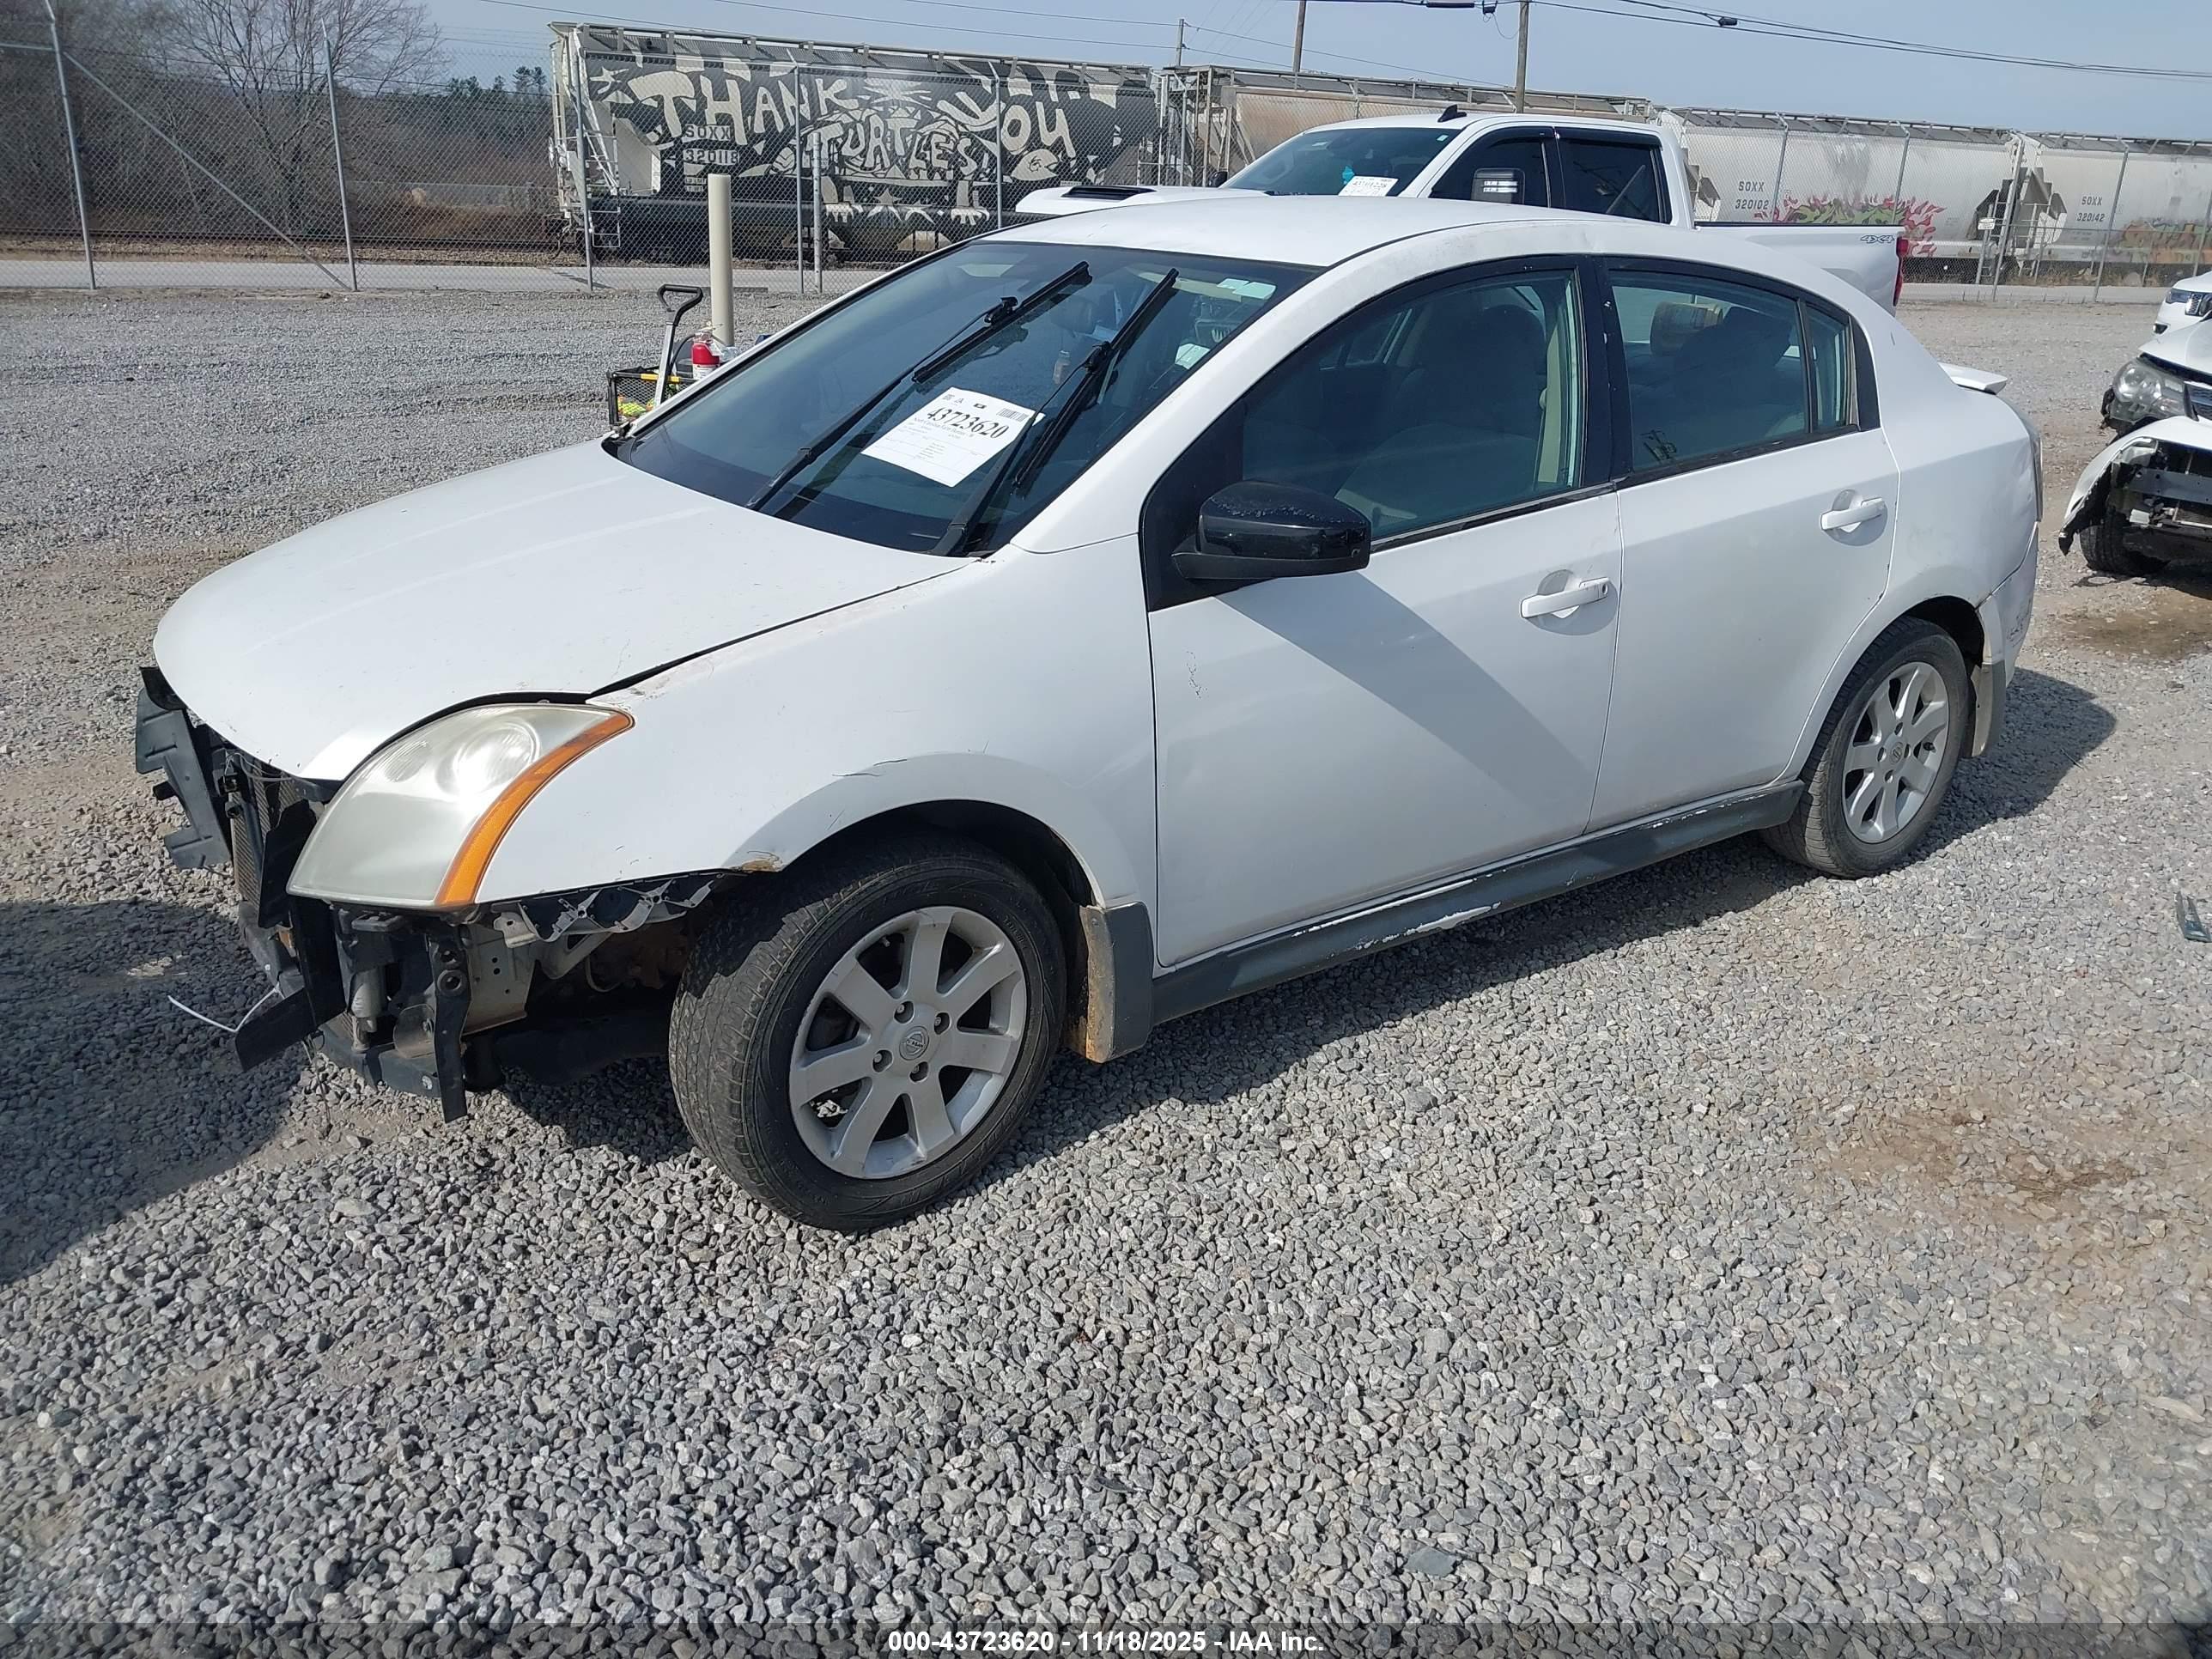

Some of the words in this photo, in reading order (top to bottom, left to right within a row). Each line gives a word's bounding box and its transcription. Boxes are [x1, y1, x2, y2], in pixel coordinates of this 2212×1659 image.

[628, 71, 860, 145] THANK
[937, 92, 1076, 158] YOU
[686, 125, 731, 140] SOXX
[685, 149, 738, 164] 320118
[1738, 180, 1765, 191] SOXX
[1735, 199, 1769, 210] 320102
[2081, 196, 2103, 206] SOXX
[927, 407, 1010, 439] 43723620
